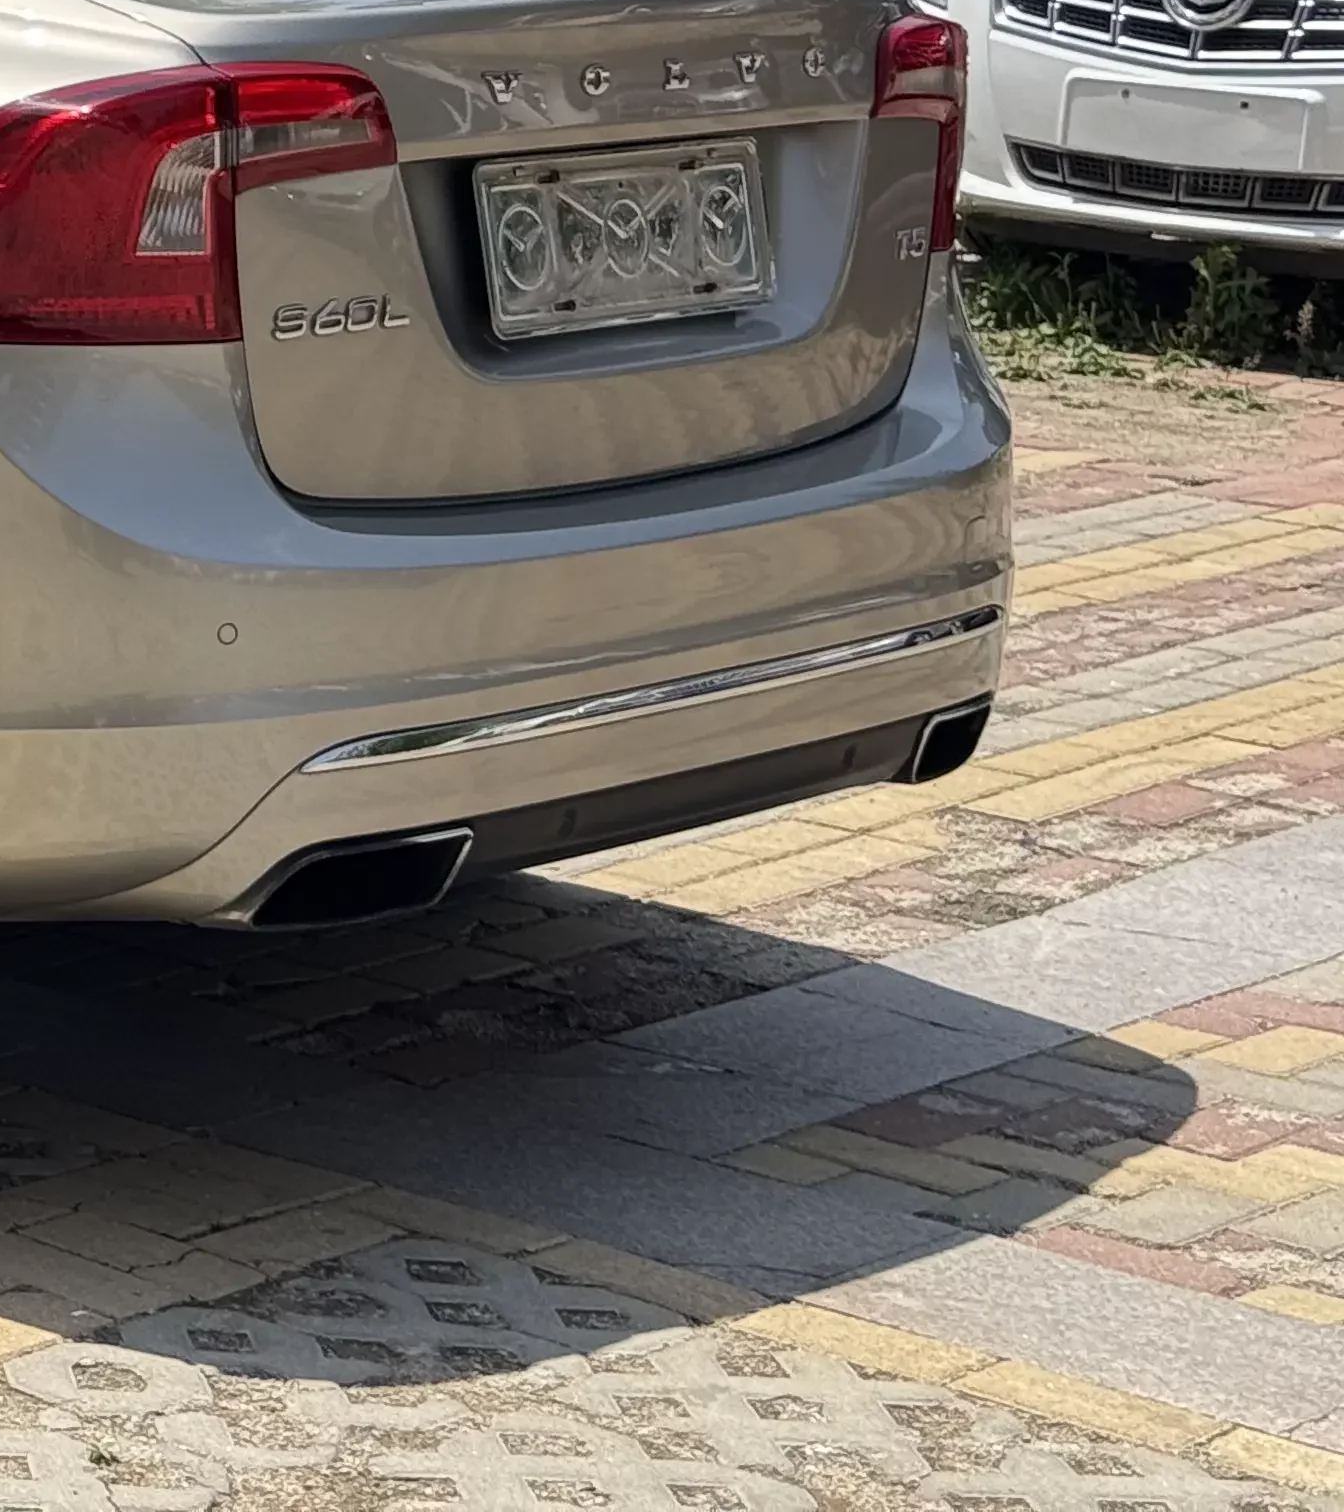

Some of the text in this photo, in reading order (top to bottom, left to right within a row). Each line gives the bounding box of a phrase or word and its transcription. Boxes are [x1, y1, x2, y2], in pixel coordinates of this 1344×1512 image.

[483, 44, 826, 105] VOLVO
[894, 225, 928, 261] T5
[270, 294, 411, 341] S60L
